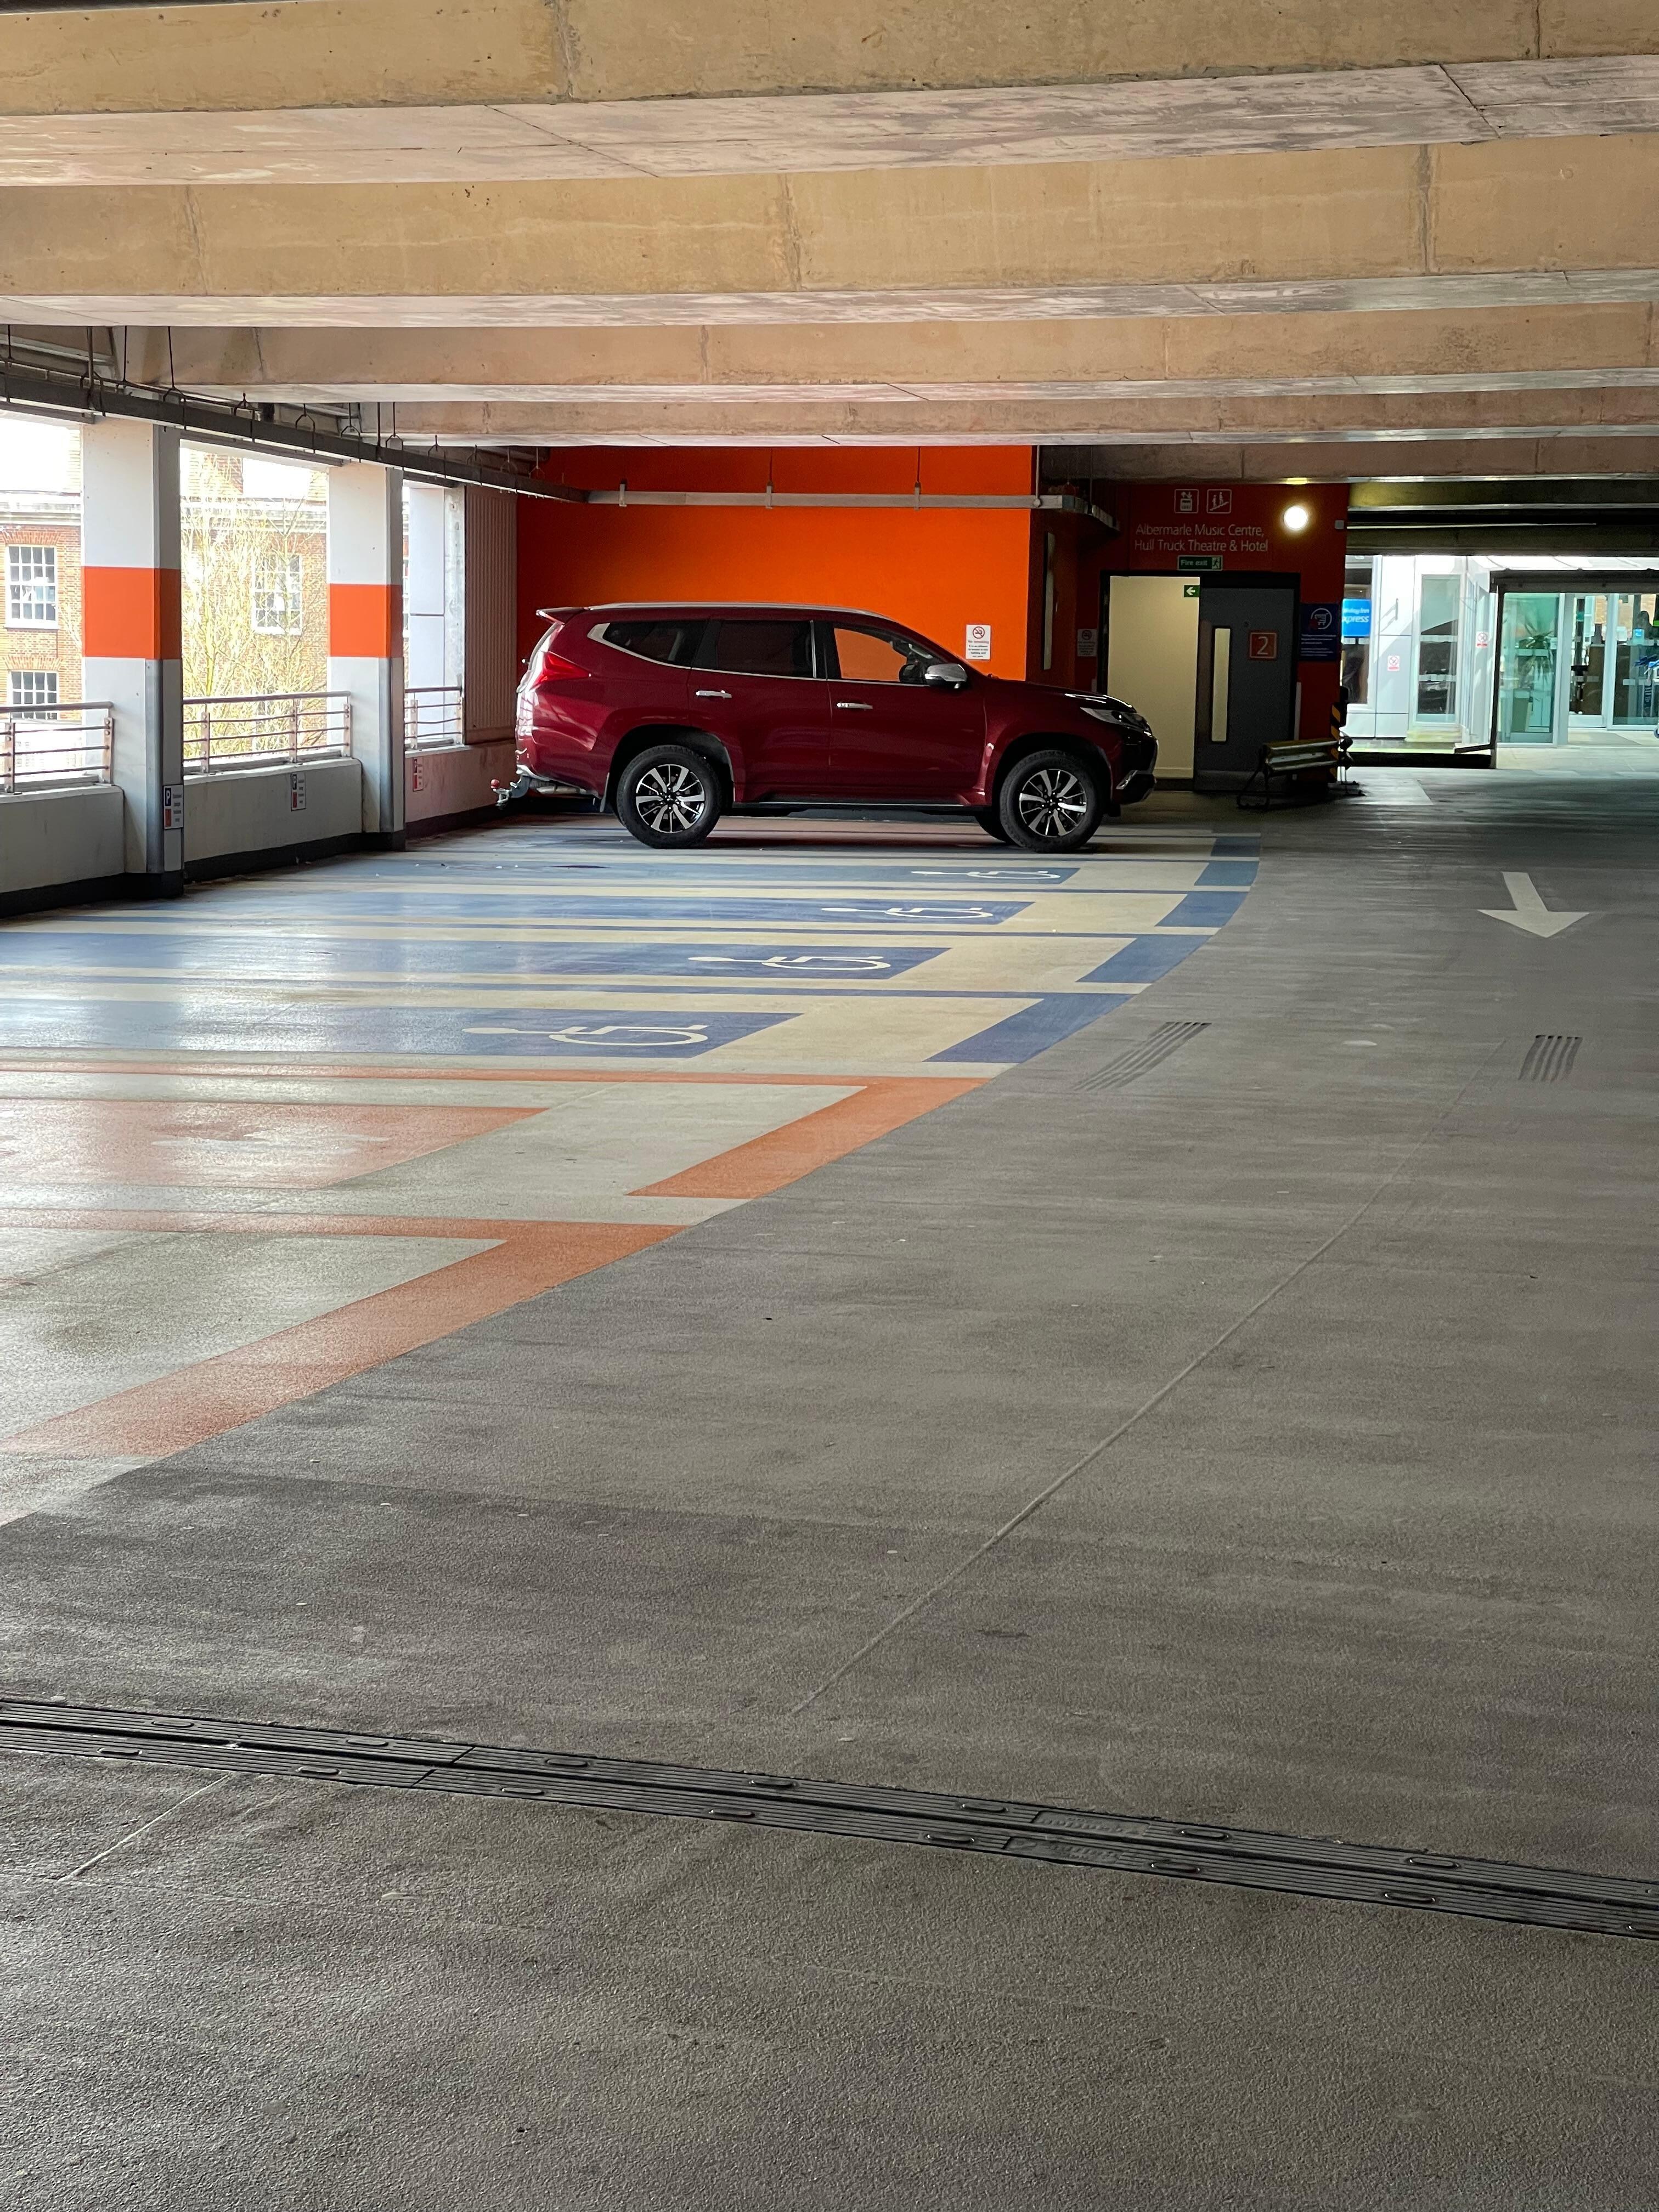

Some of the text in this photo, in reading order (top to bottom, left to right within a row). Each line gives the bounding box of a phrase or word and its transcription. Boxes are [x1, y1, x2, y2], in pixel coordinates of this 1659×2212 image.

[1135, 523, 1265, 537] Albermarle Music Centre,
[1134, 539, 1268, 551] Hull Truck Theatre & Hotel
[1257, 636, 1269, 654] 2
[166, 790, 171, 804] P
